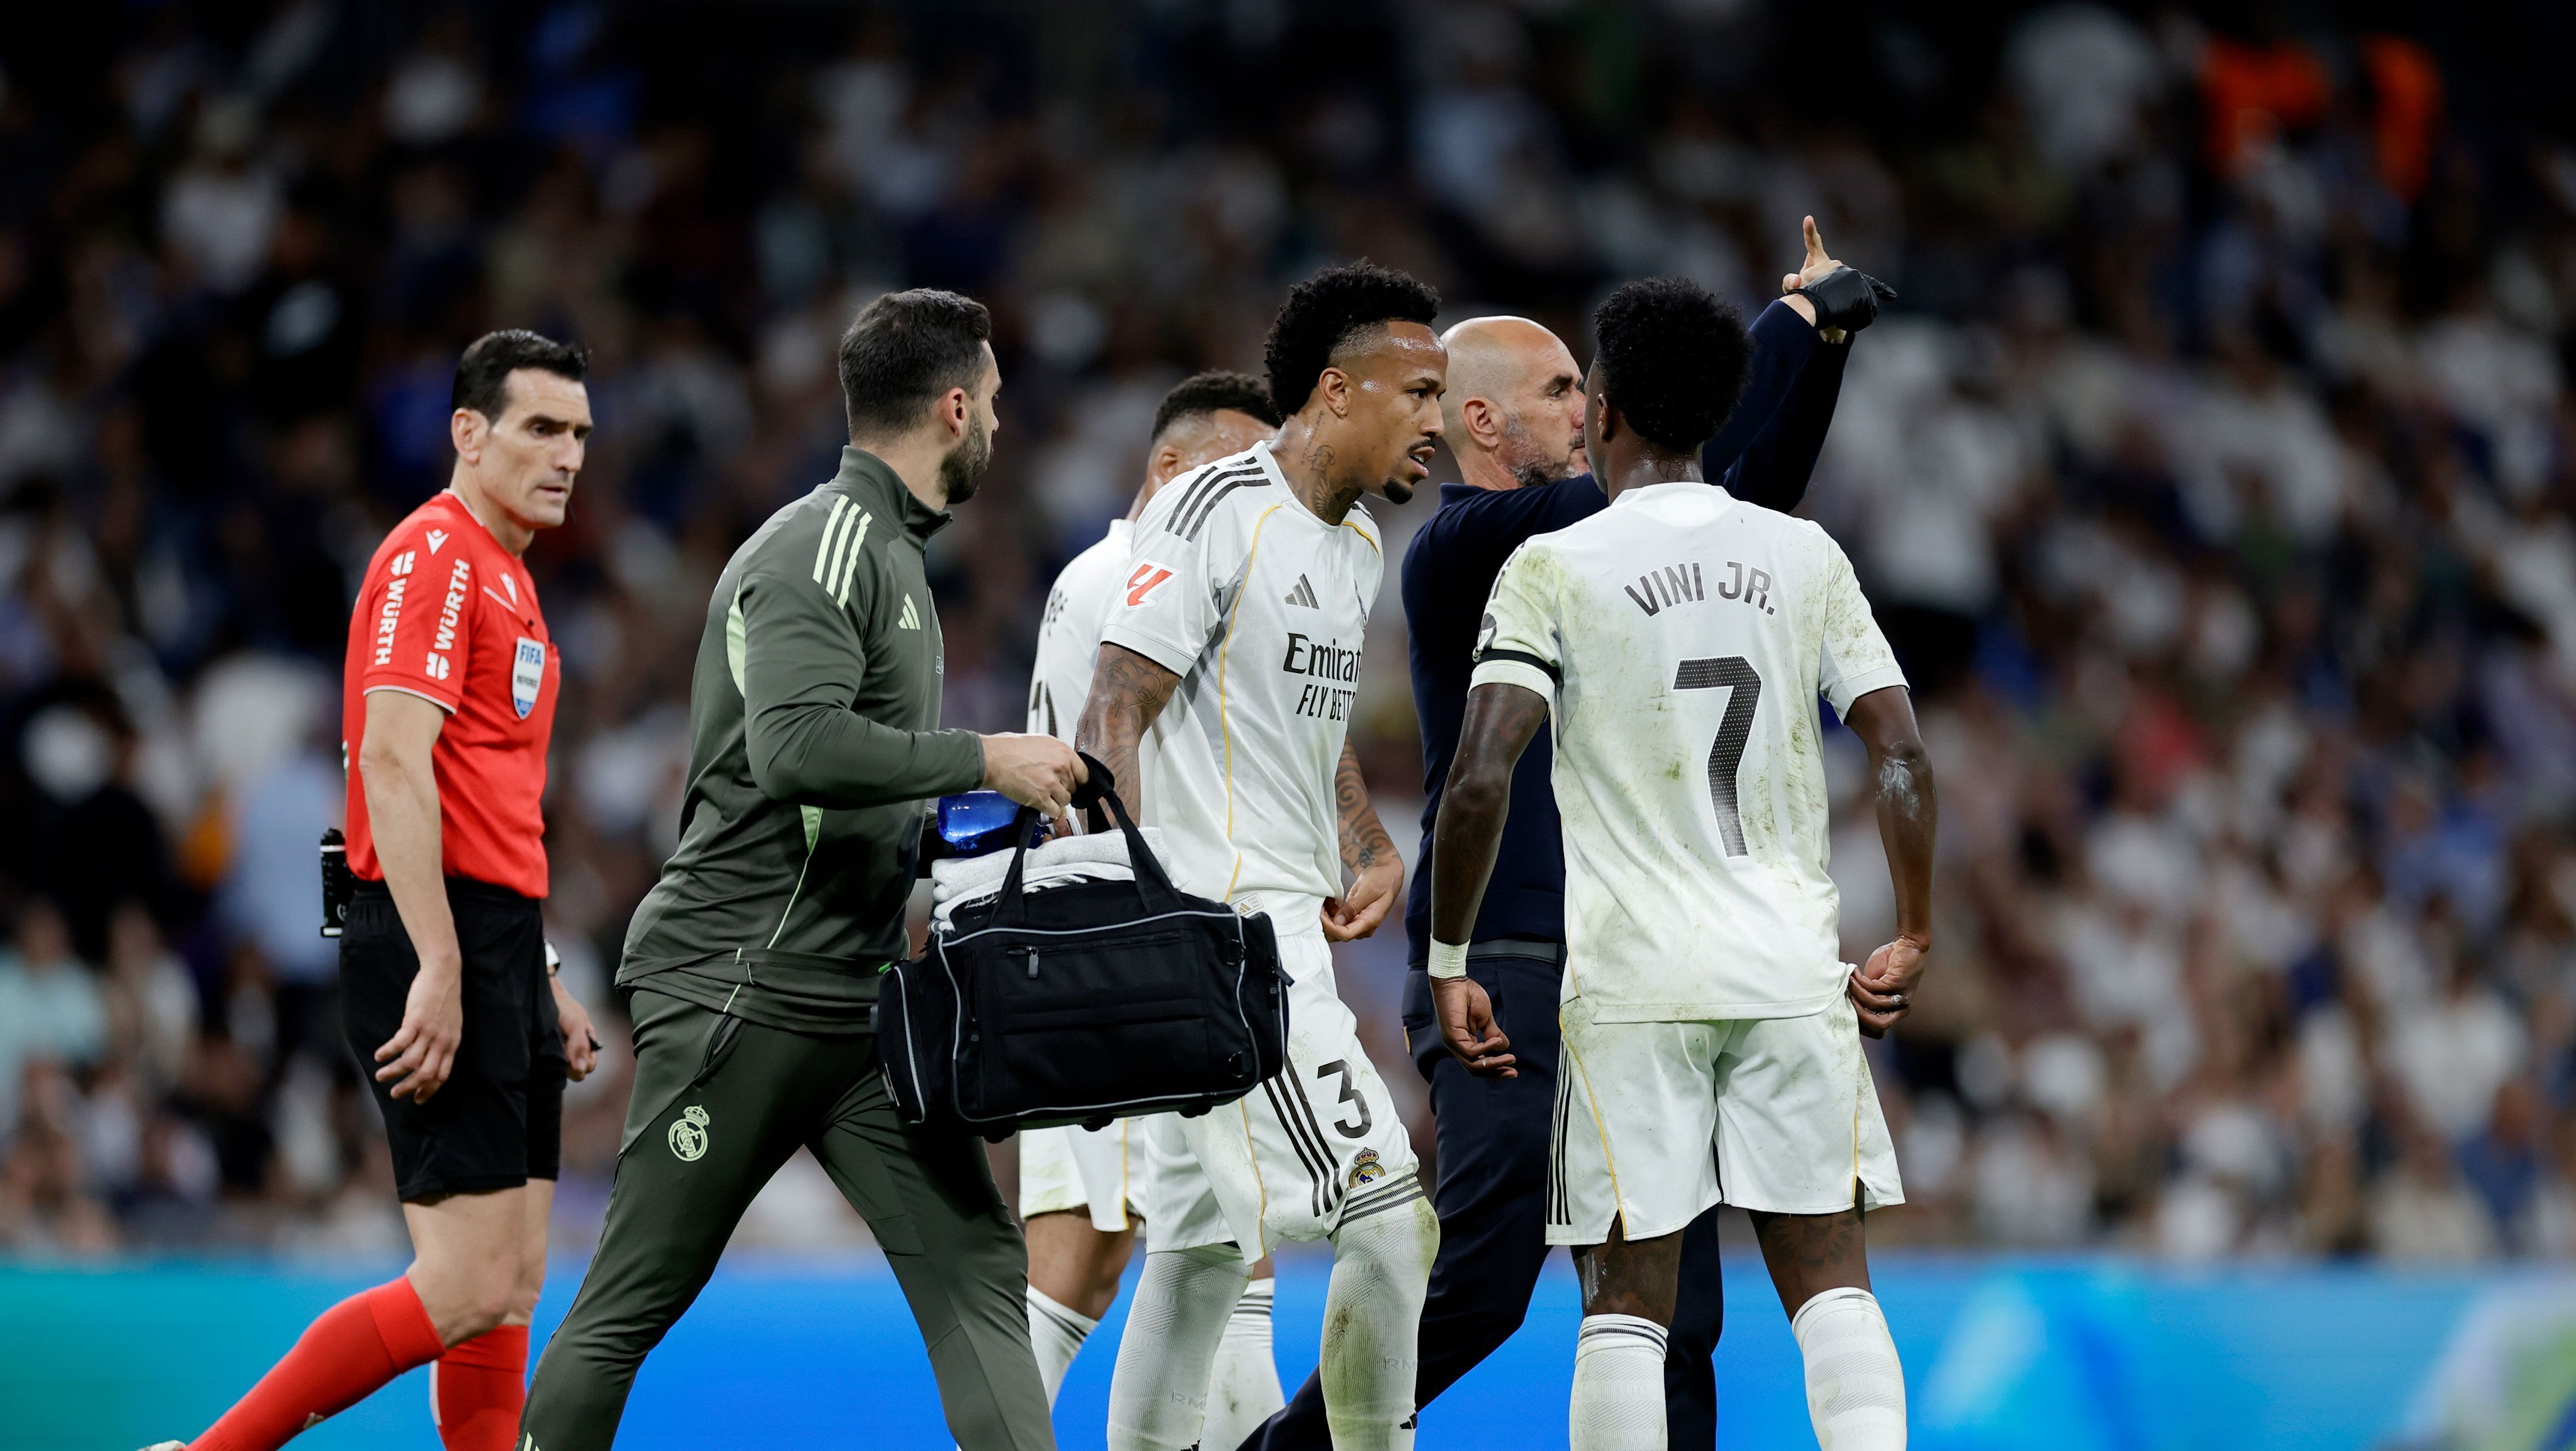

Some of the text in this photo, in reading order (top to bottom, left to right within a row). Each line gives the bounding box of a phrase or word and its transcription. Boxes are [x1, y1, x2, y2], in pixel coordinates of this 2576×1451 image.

[375, 578, 407, 665] WÜRTH
[434, 558, 470, 650] WÜRTH
[1624, 561, 1775, 617] VINI JR.
[520, 644, 541, 665] FIFA
[1283, 632, 1361, 683] Emirat
[1296, 684, 1329, 718] FLY
[1672, 655, 1761, 858] 7
[1317, 1059, 1372, 1139] 3
